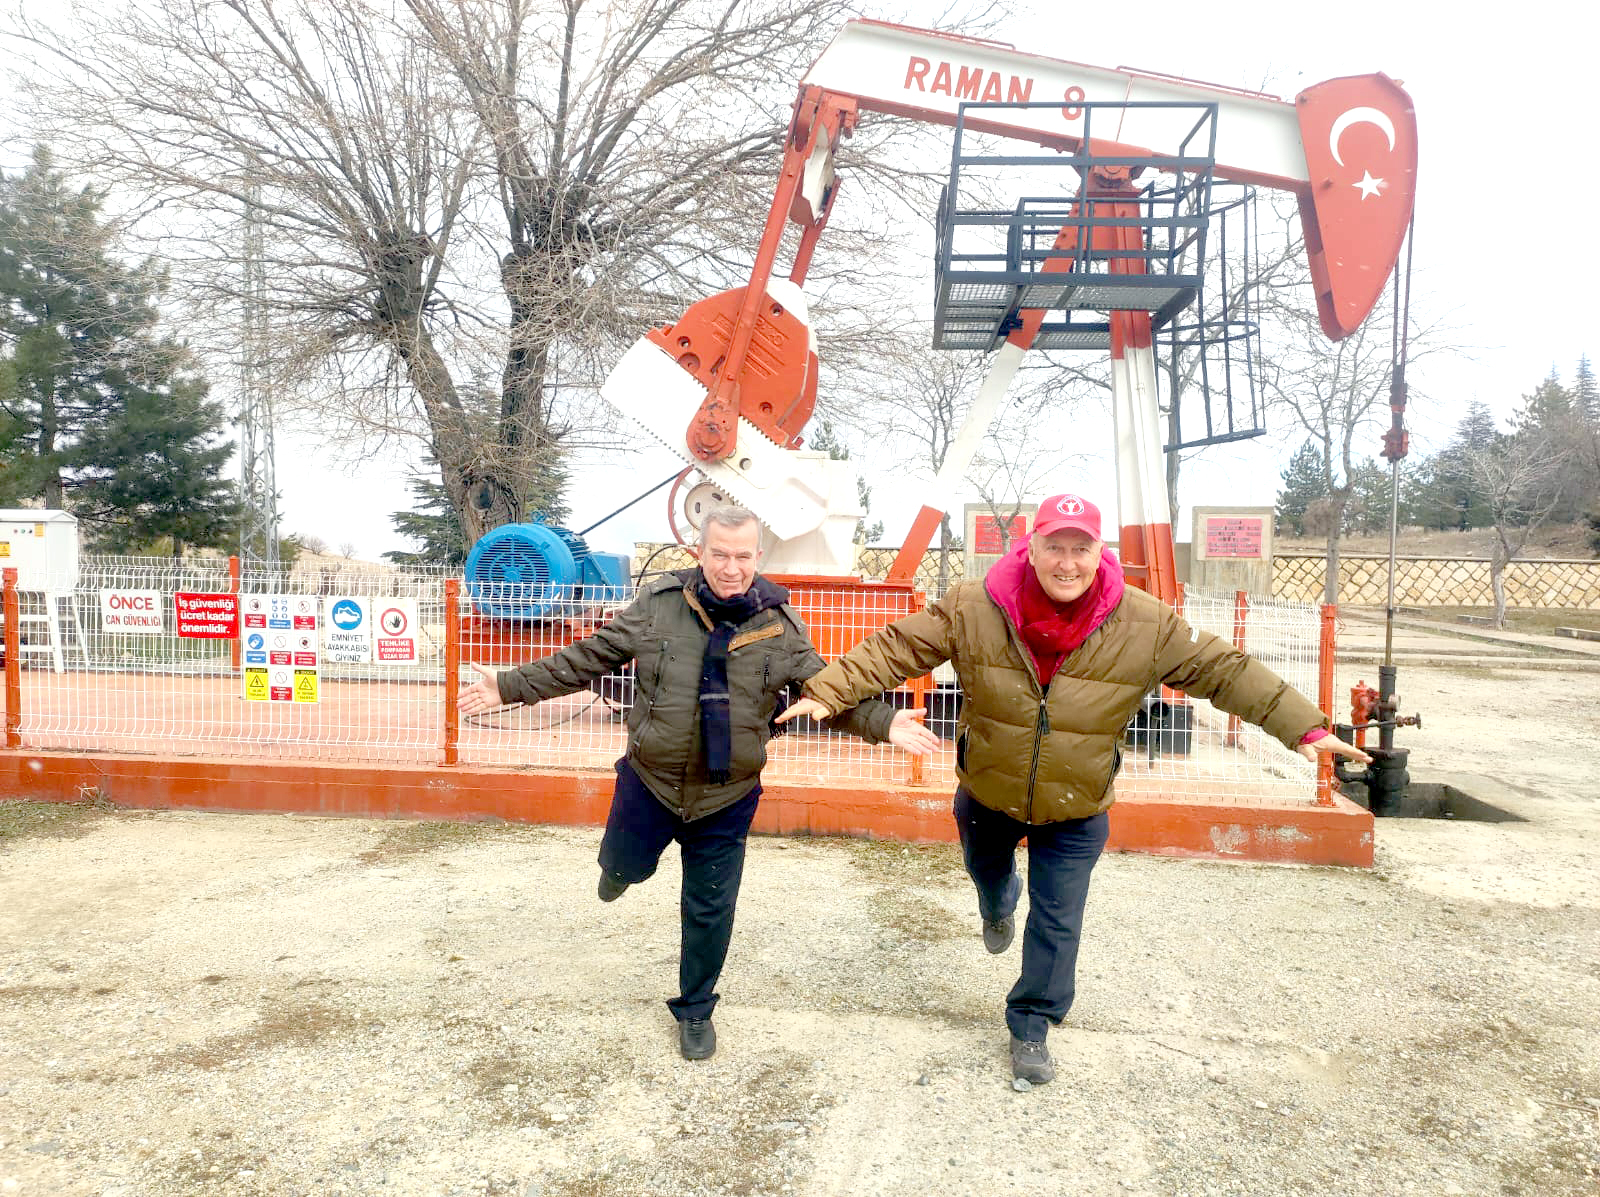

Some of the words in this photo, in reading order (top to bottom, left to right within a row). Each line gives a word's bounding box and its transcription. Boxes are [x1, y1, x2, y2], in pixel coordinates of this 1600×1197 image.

[904, 56, 1034, 109] RAMAN
[1061, 86, 1085, 121] 8
[109, 594, 154, 611] ÖNCE
[190, 600, 234, 611] güvenliği
[106, 615, 121, 625] CAN
[181, 611, 206, 621] ücret
[207, 611, 234, 621] kadar
[181, 623, 230, 634] önemlidir.
[331, 632, 363, 642] EMNİYET
[328, 643, 369, 652] AYAKKABISI
